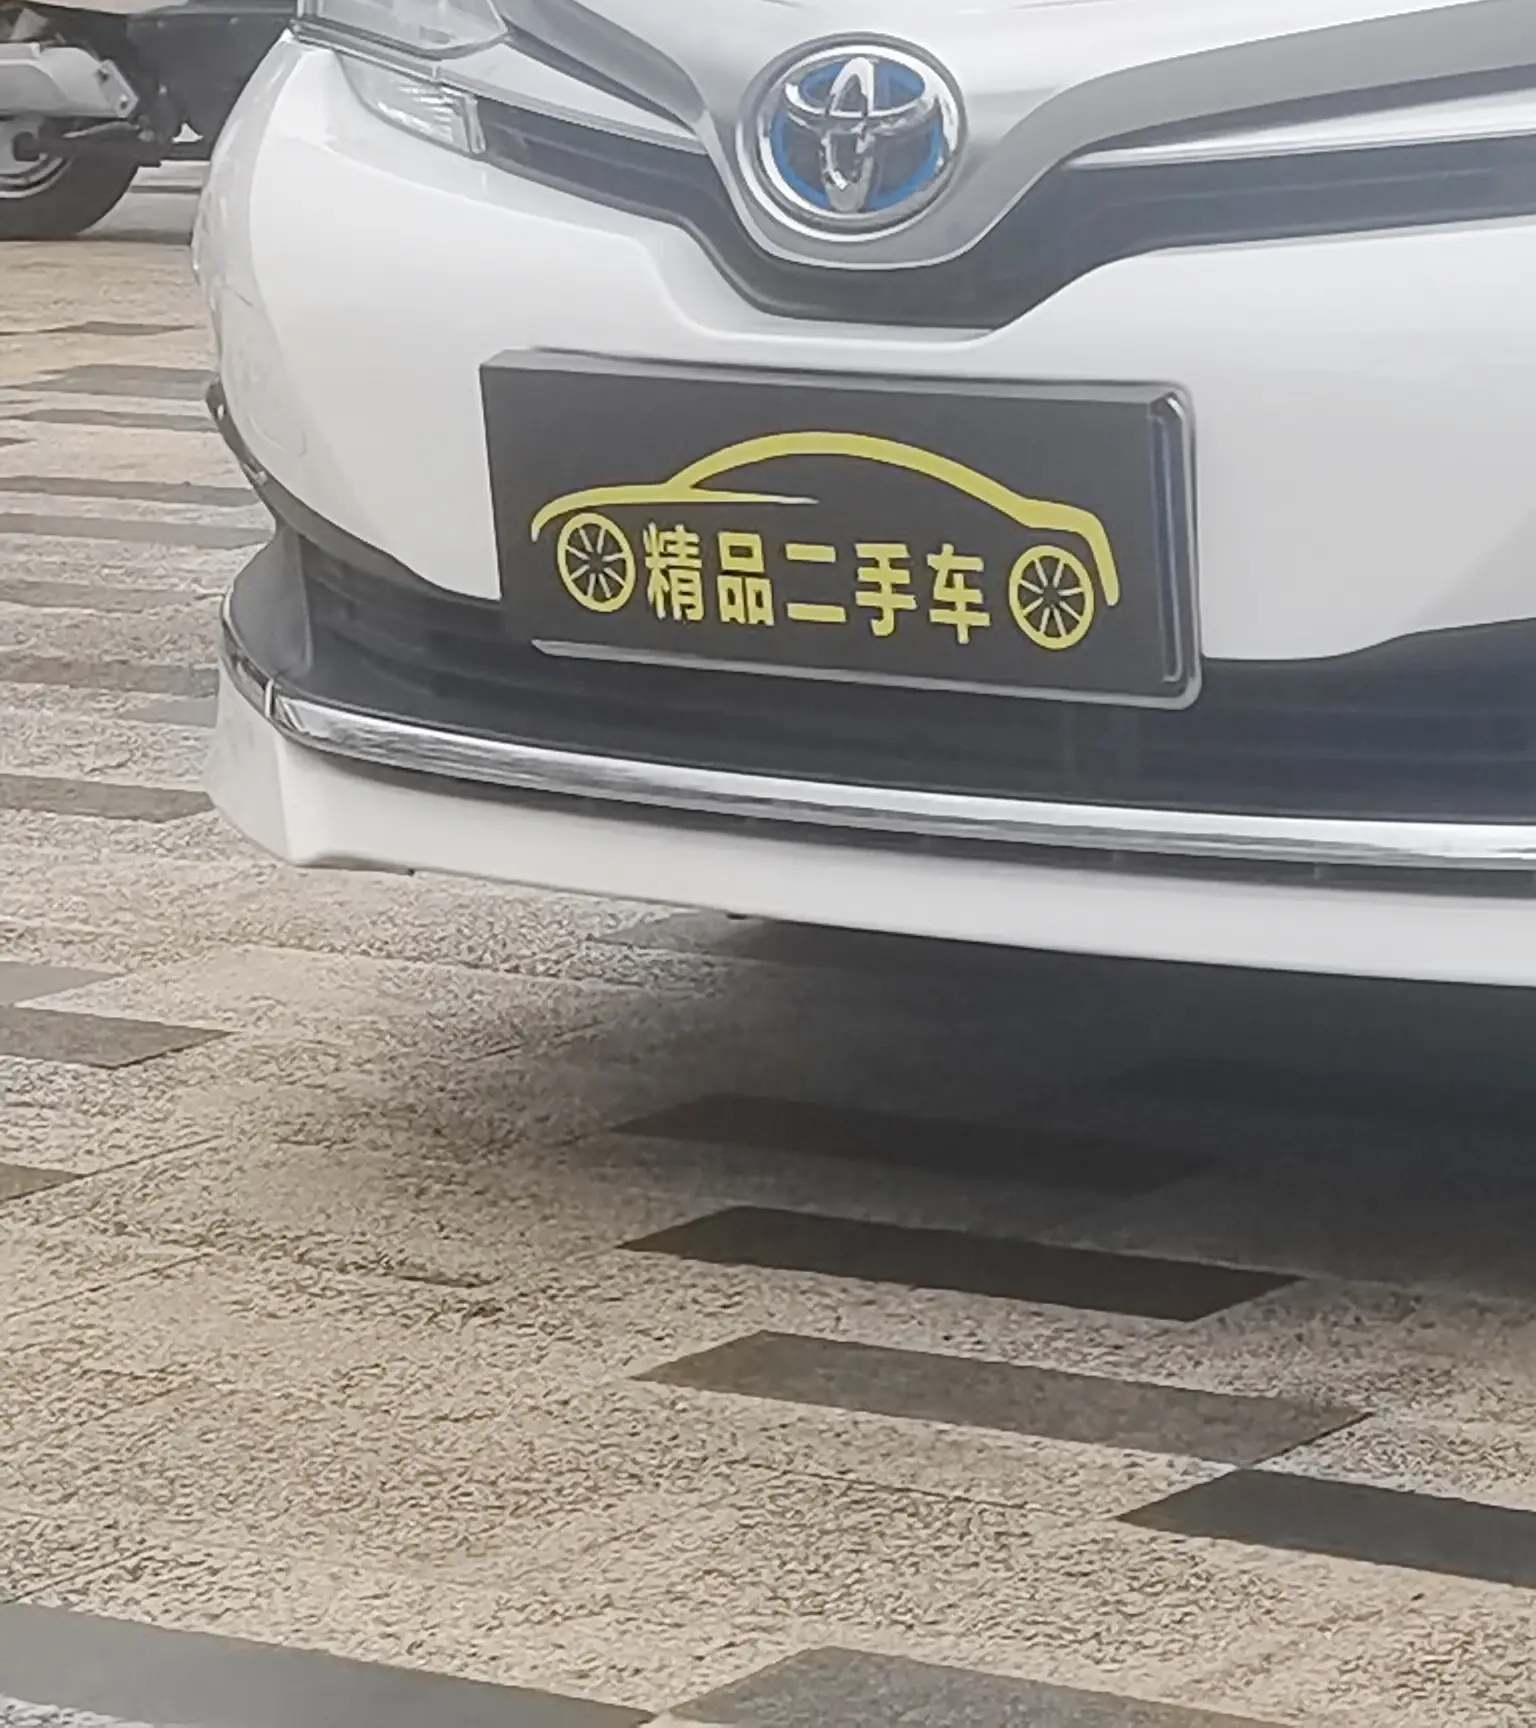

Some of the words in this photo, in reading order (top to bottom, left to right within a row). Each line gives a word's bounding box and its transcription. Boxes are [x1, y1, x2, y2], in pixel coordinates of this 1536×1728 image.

[643, 522, 990, 644] 精品二手车
